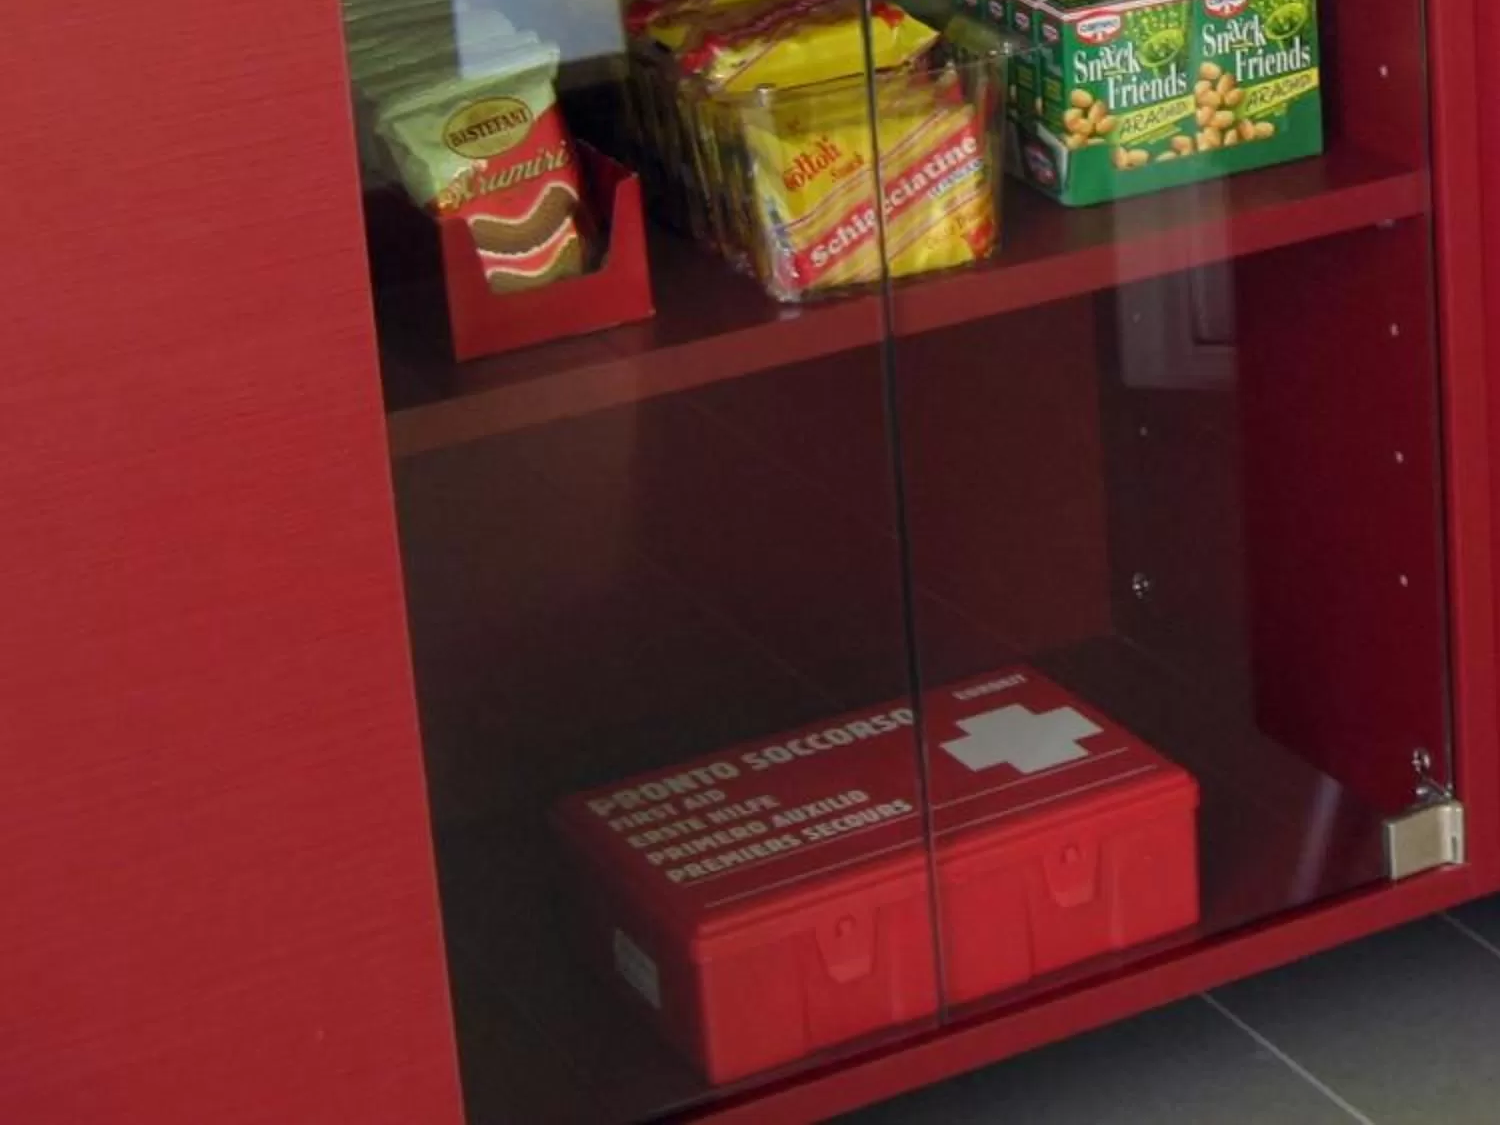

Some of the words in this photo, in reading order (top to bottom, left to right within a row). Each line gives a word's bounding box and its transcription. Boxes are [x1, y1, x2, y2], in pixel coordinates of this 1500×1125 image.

[1201, 14, 1267, 58] Snack
[1235, 36, 1312, 82] Friends
[1073, 41, 1141, 84] Snack
[1108, 62, 1188, 111] Friends
[587, 761, 740, 817] PRONTO
[741, 707, 915, 770] SOCCORSO
